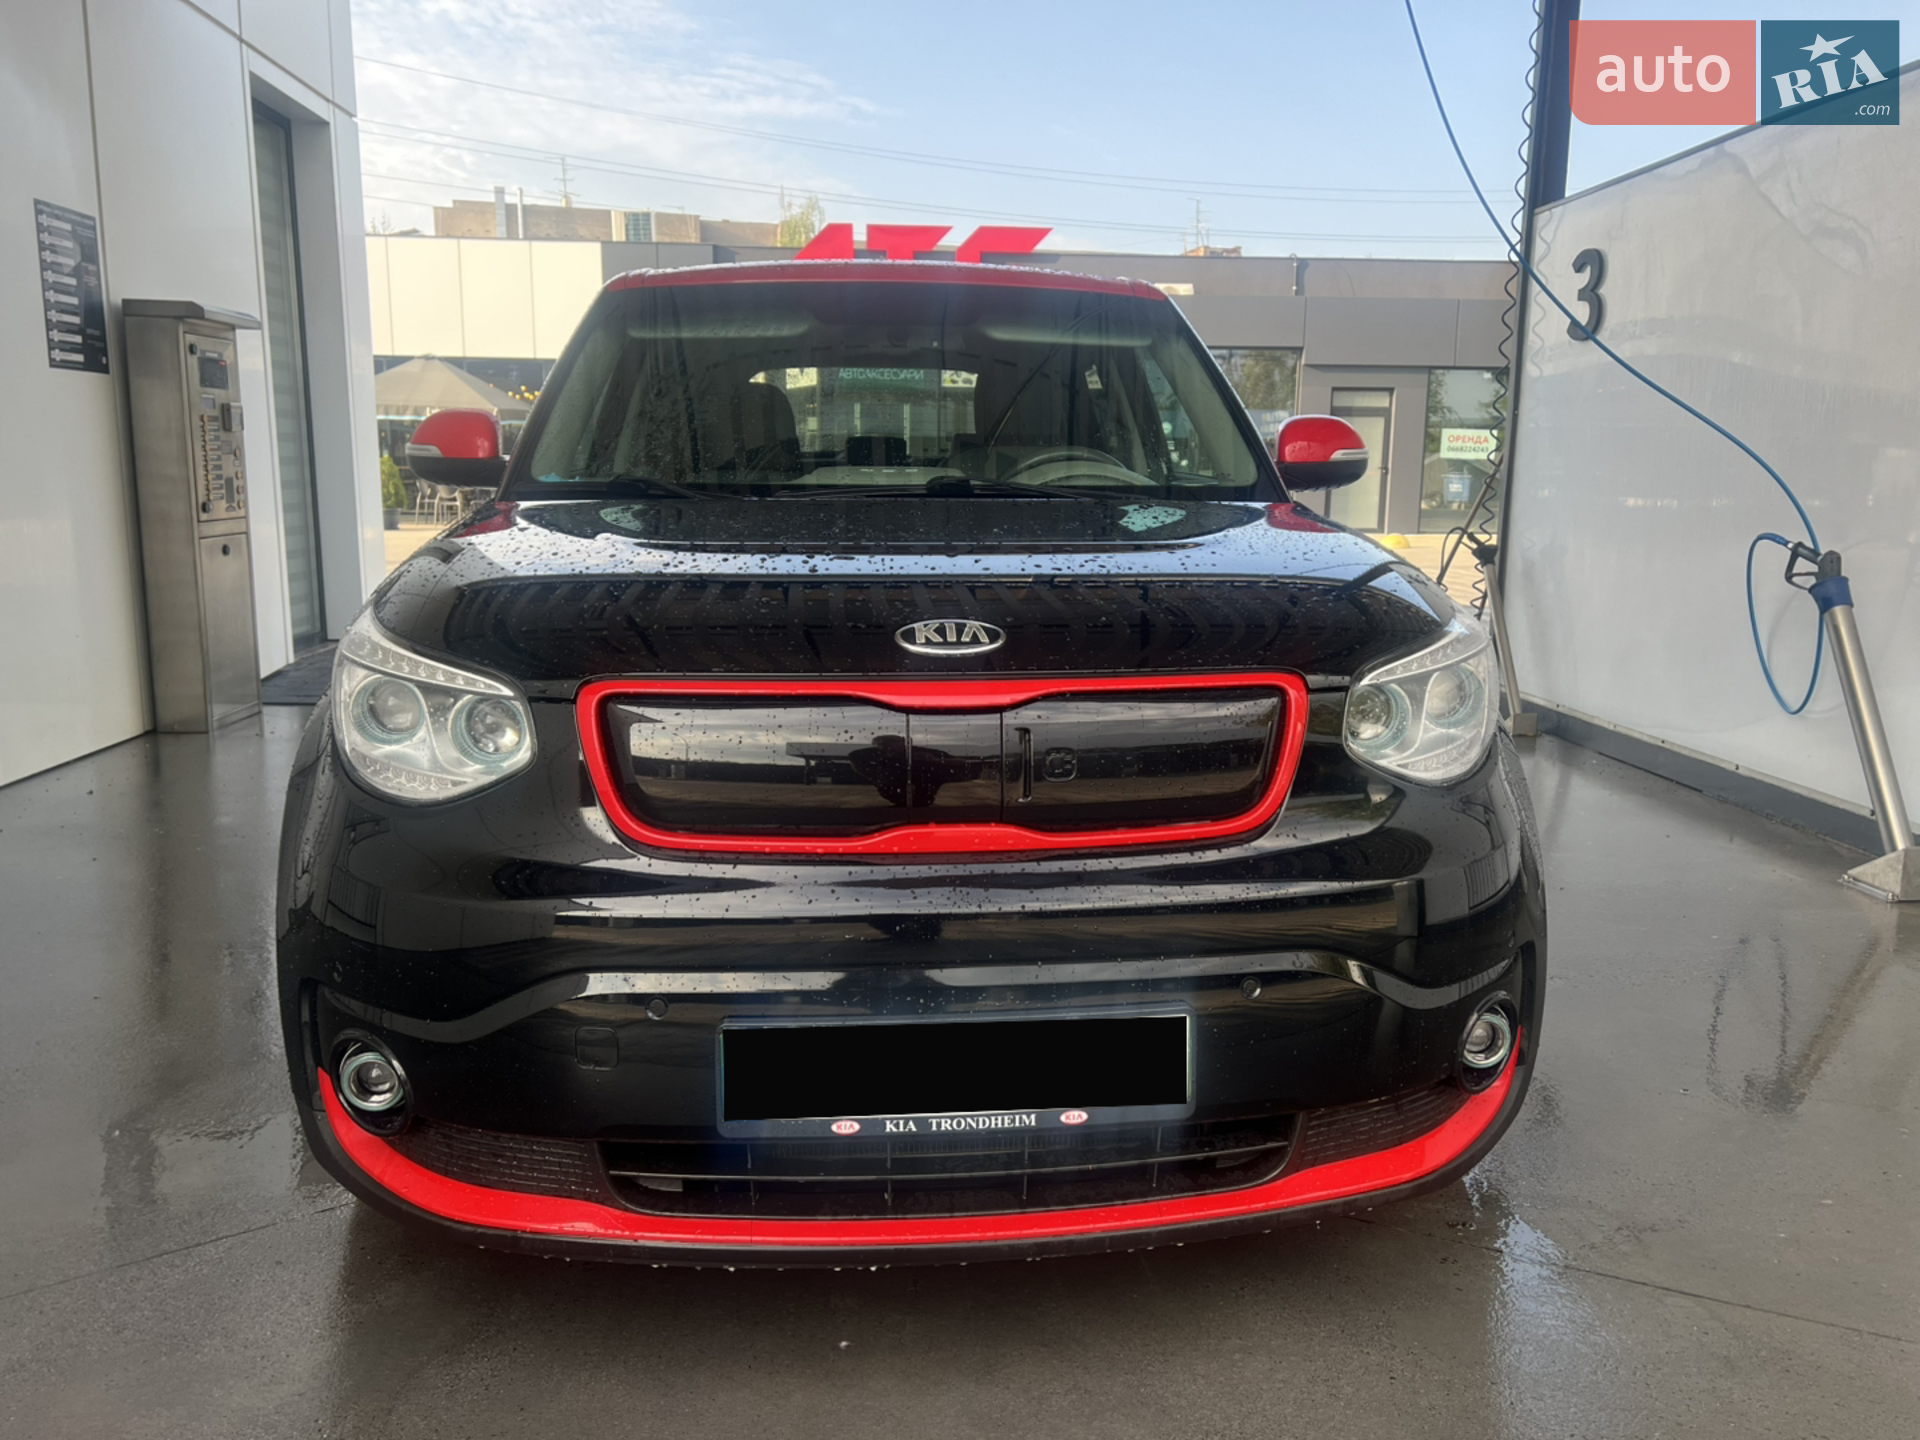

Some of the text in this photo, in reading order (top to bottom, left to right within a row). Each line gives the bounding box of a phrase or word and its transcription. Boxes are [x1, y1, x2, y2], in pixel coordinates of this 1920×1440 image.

[1566, 247, 1605, 342] 3
[1447, 434, 1489, 445] ОРЕНДА
[914, 622, 990, 644] KIA
[885, 1113, 1037, 1132] KIA TRONDHEIM
[1063, 1112, 1083, 1122] KIA
[836, 1122, 855, 1132] KIA
